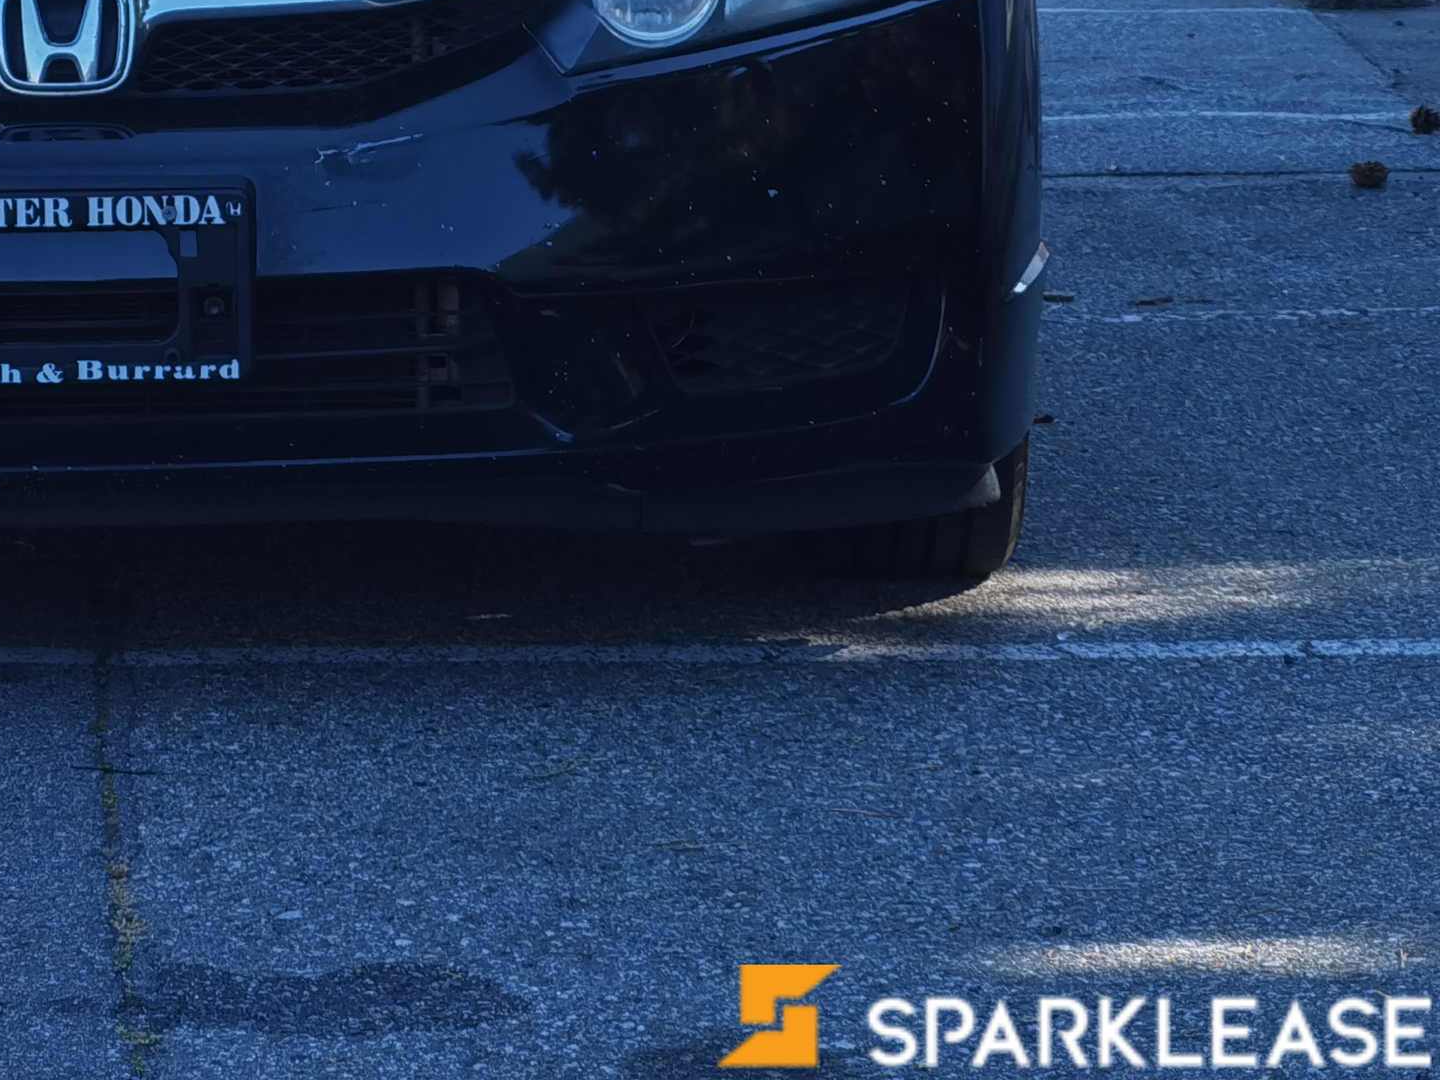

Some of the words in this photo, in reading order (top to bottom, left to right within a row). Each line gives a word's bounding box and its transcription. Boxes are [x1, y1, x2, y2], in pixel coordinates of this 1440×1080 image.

[87, 195, 226, 228] HONDA
[36, 362, 64, 384] &
[76, 358, 241, 381] Burrard
